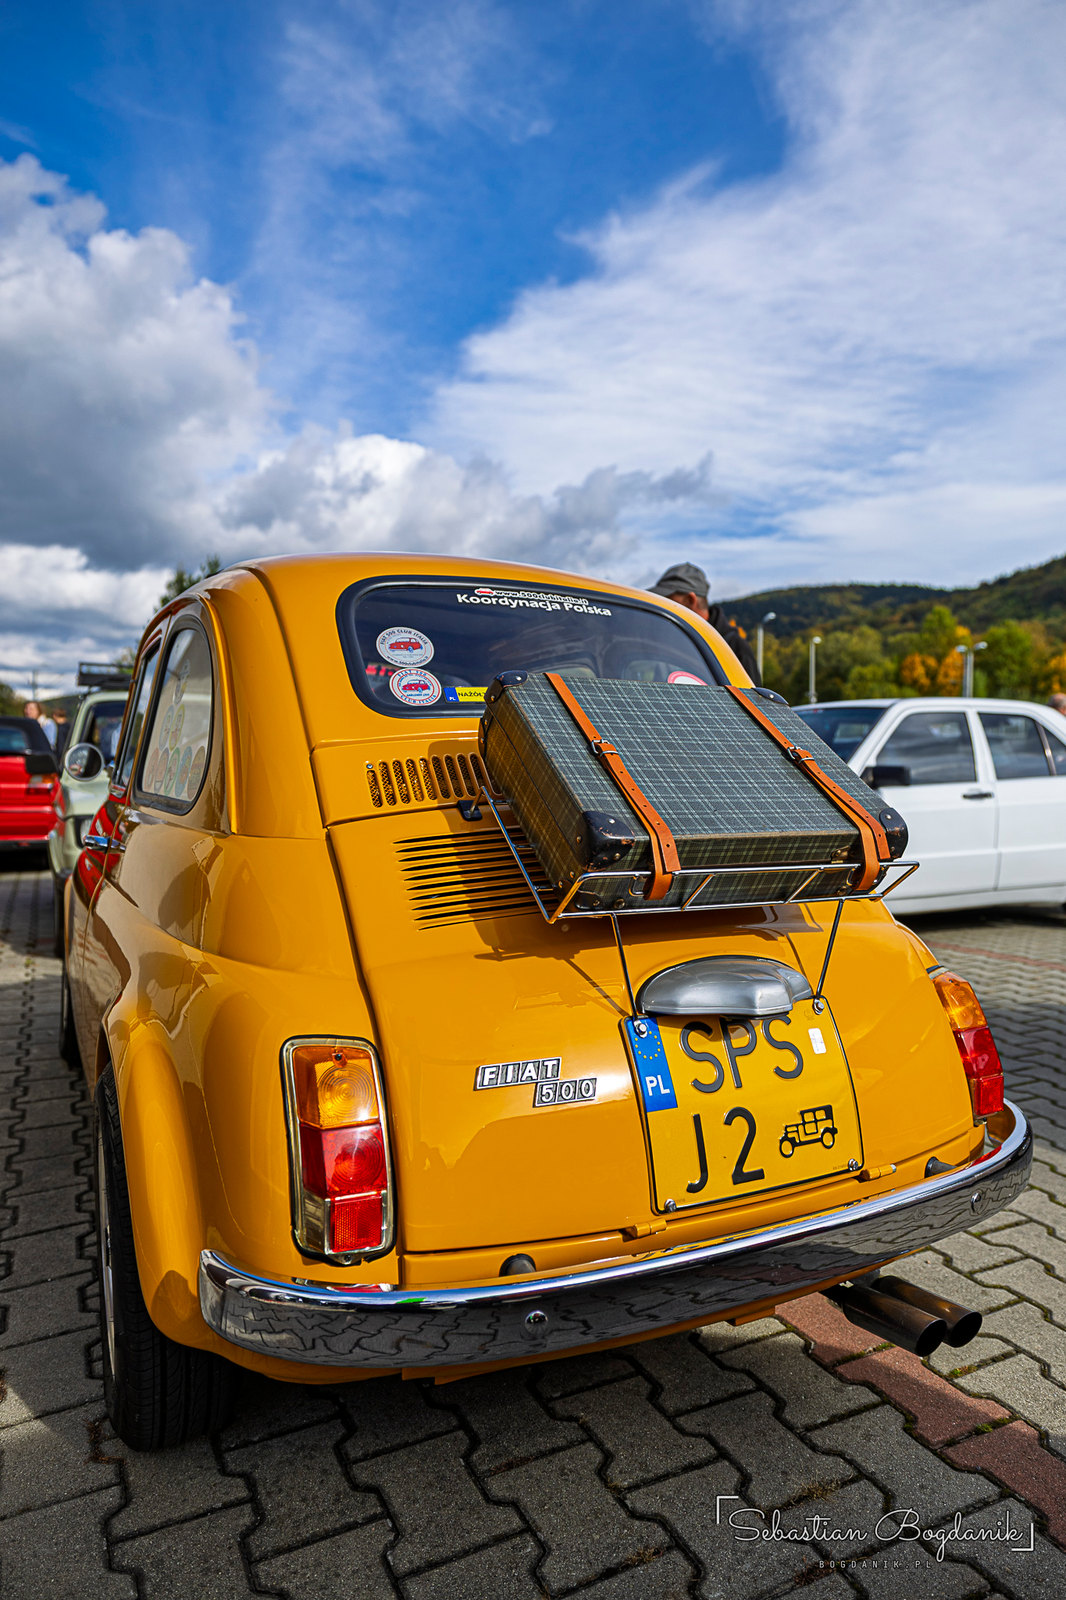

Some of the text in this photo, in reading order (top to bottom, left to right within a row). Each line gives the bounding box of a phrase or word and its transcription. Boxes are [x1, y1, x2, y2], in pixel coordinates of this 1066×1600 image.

[456, 593, 612, 616] Koordynacja Polska
[679, 1015, 804, 1094] SPS
[482, 1059, 558, 1086] FIAT
[541, 1079, 594, 1103] 500
[644, 1074, 671, 1097] PL
